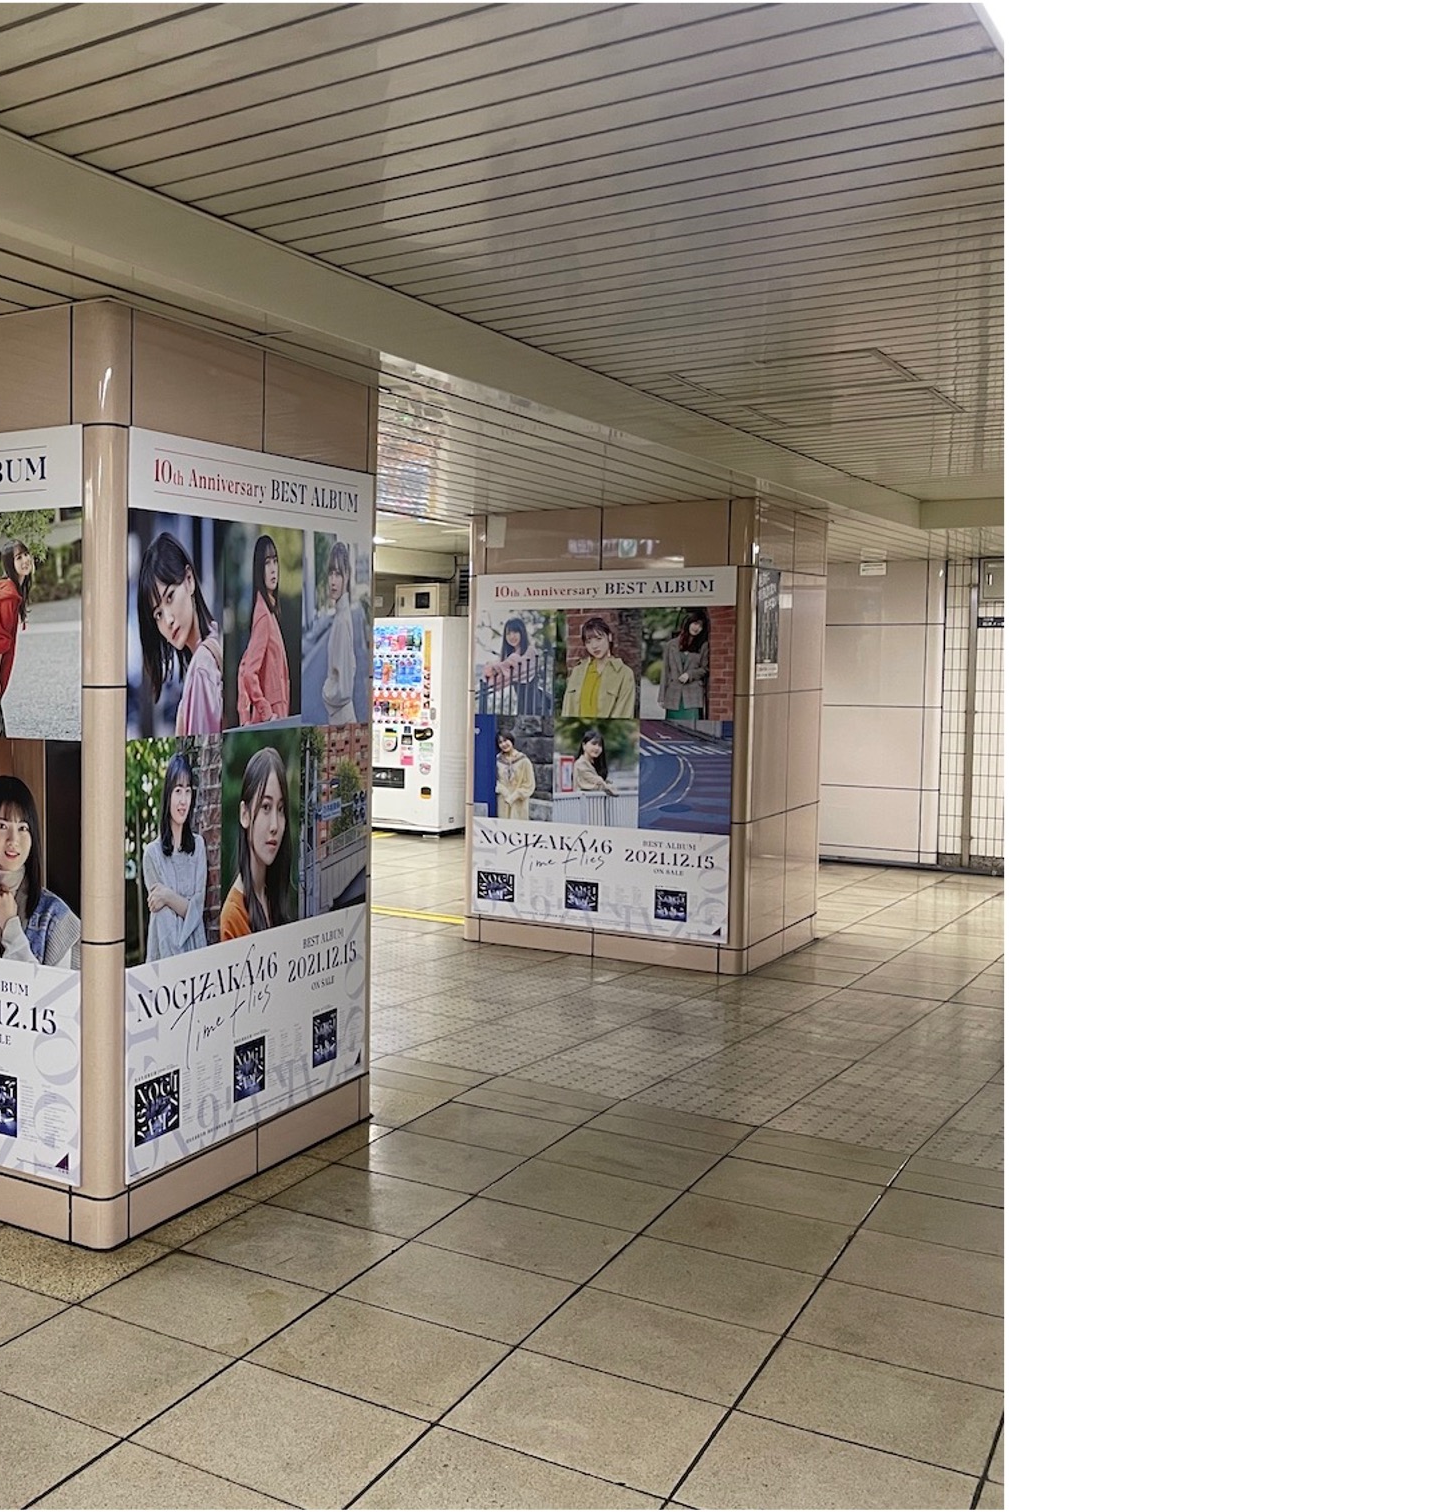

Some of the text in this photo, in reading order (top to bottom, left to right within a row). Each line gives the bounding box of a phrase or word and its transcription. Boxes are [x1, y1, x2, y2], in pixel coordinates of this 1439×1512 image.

[153, 457, 359, 513] 10th Anniversary BEST ALBUM
[494, 579, 715, 600] 10th Anniversary BEST ALBUM
[479, 829, 613, 855] NOGIZAKA46
[642, 840, 697, 852] BEST ALBUM
[624, 848, 715, 870] 2021.12.15
[302, 927, 345, 950] BEST ALBUM
[288, 940, 357, 983] 2021.12.15
[137, 951, 278, 1023] NOGIZAKA46
